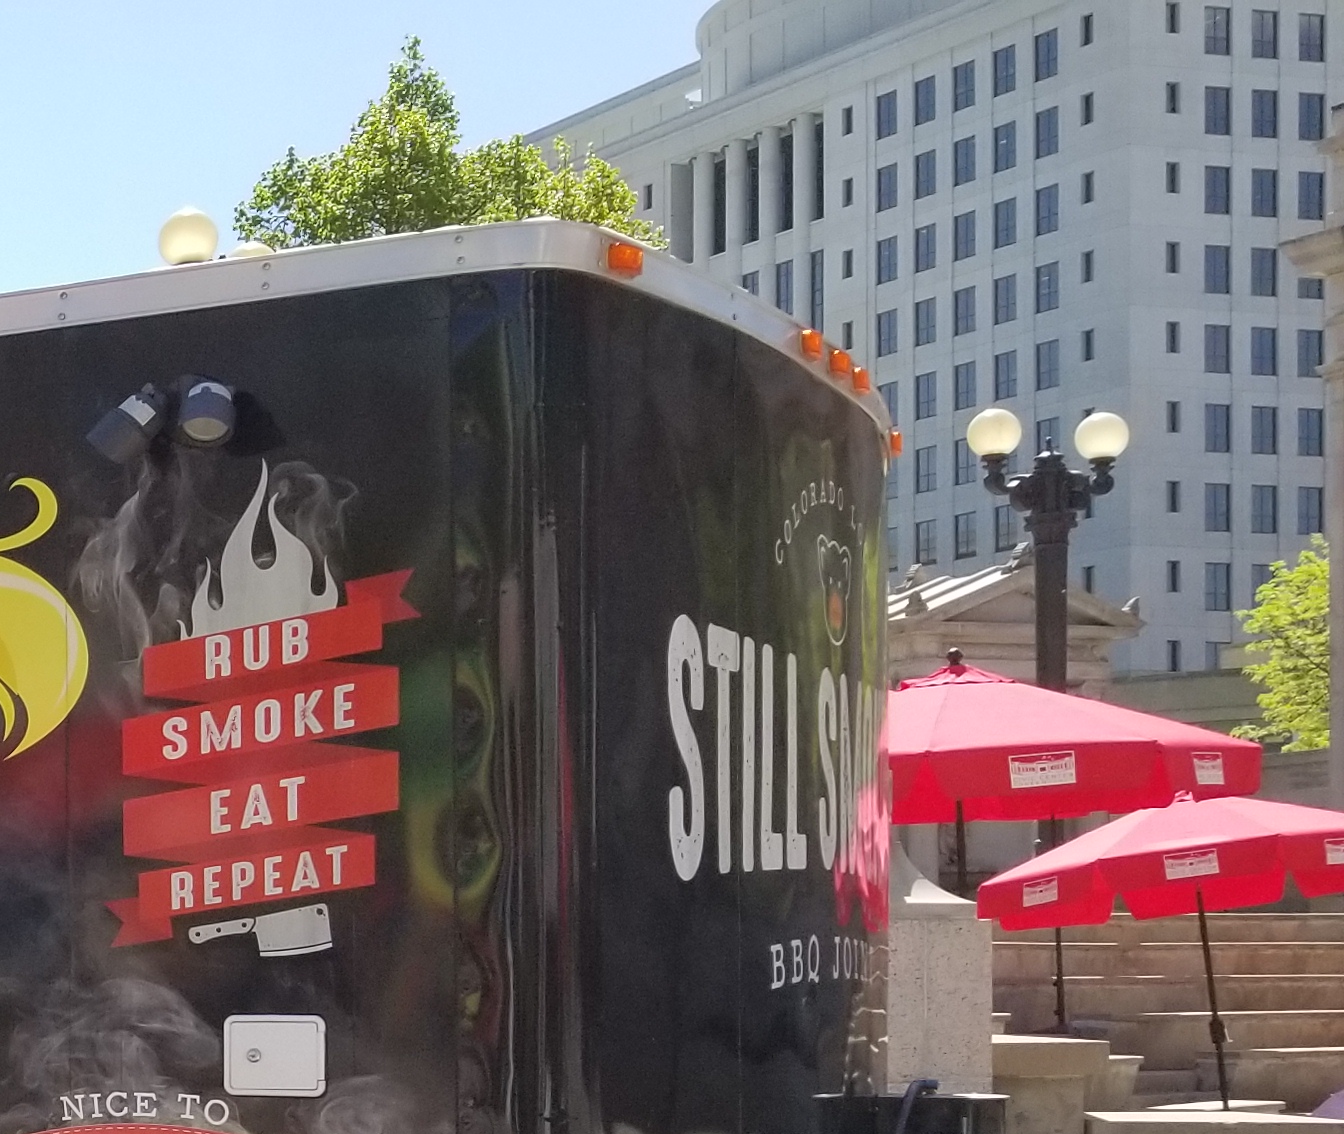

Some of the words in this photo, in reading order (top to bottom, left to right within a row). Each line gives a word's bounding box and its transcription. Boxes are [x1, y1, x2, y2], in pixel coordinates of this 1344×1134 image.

[774, 479, 845, 565] COLORADO
[204, 618, 310, 681] RUB
[161, 683, 357, 761] SMOKE
[667, 614, 808, 881] STILL
[209, 775, 307, 835] EAT
[170, 845, 348, 911] REPEAT
[770, 933, 820, 990] BBQ
[59, 1092, 159, 1122] NICE
[178, 1093, 231, 1126] TO
